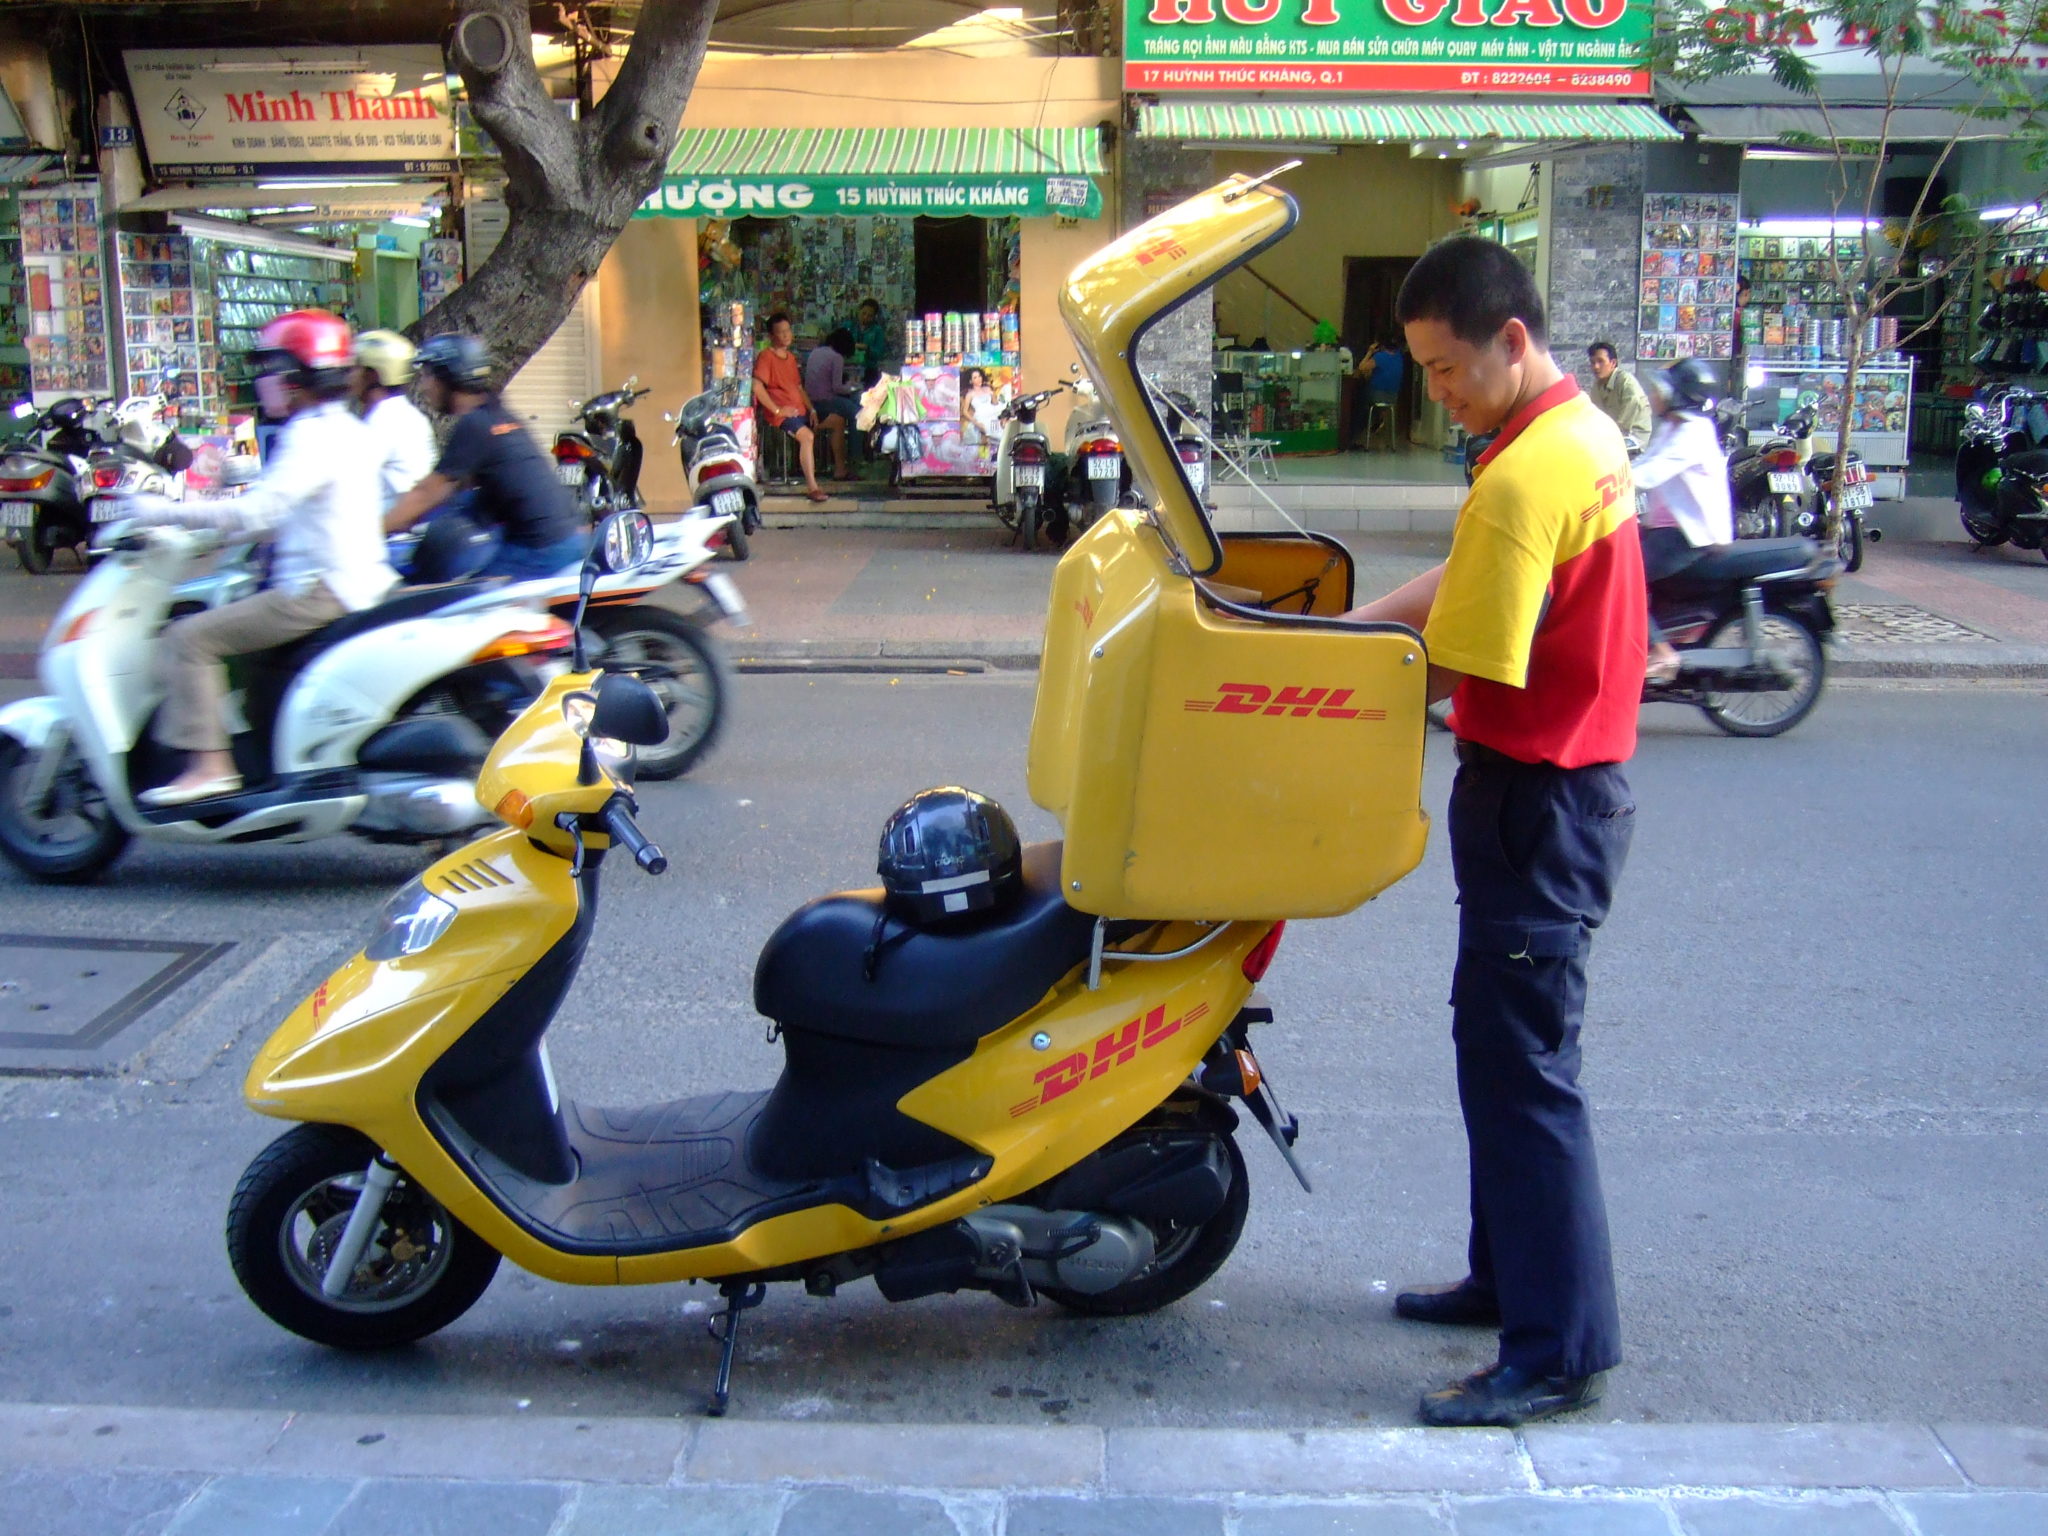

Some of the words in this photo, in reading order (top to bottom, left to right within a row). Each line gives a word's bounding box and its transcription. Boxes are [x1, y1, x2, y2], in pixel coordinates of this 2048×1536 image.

[1144, 36, 1180, 55] TRÁNG
[1183, 40, 1202, 59] RỌI
[1205, 34, 1227, 55] ẢNH
[1289, 40, 1307, 55] KTS
[1317, 41, 1340, 55] MUA
[1343, 36, 1365, 55] BÁN
[1368, 36, 1389, 55] SỬA
[1421, 37, 1444, 56] MÁY
[1447, 41, 1477, 57] QUAY
[1481, 38, 1503, 57] MÁY
[1507, 37, 1529, 57] ẢNH
[1538, 39, 1558, 62] VẬT
[1560, 41, 1574, 57] TƯ
[1577, 39, 1616, 58] NGÀNH
[1143, 70, 1159, 83] 17
[1163, 67, 1214, 82] HUỲNH
[1218, 66, 1255, 82] THÚC
[1259, 67, 1316, 84] KHÁNG,
[1320, 71, 1343, 83] Q.1
[1461, 72, 1480, 84] ĐT
[1492, 72, 1551, 85] 8222604
[1571, 74, 1631, 86] 8238490
[225, 90, 317, 122] Minh
[321, 88, 439, 122] Thành
[109, 128, 128, 142] 13
[837, 188, 860, 204] 15
[866, 181, 919, 205] HUỲNH
[925, 181, 965, 205] THÚC
[969, 181, 1029, 205] KHÁNG
[1213, 683, 1361, 720] DHL
[1034, 1003, 1183, 1105] DHL
